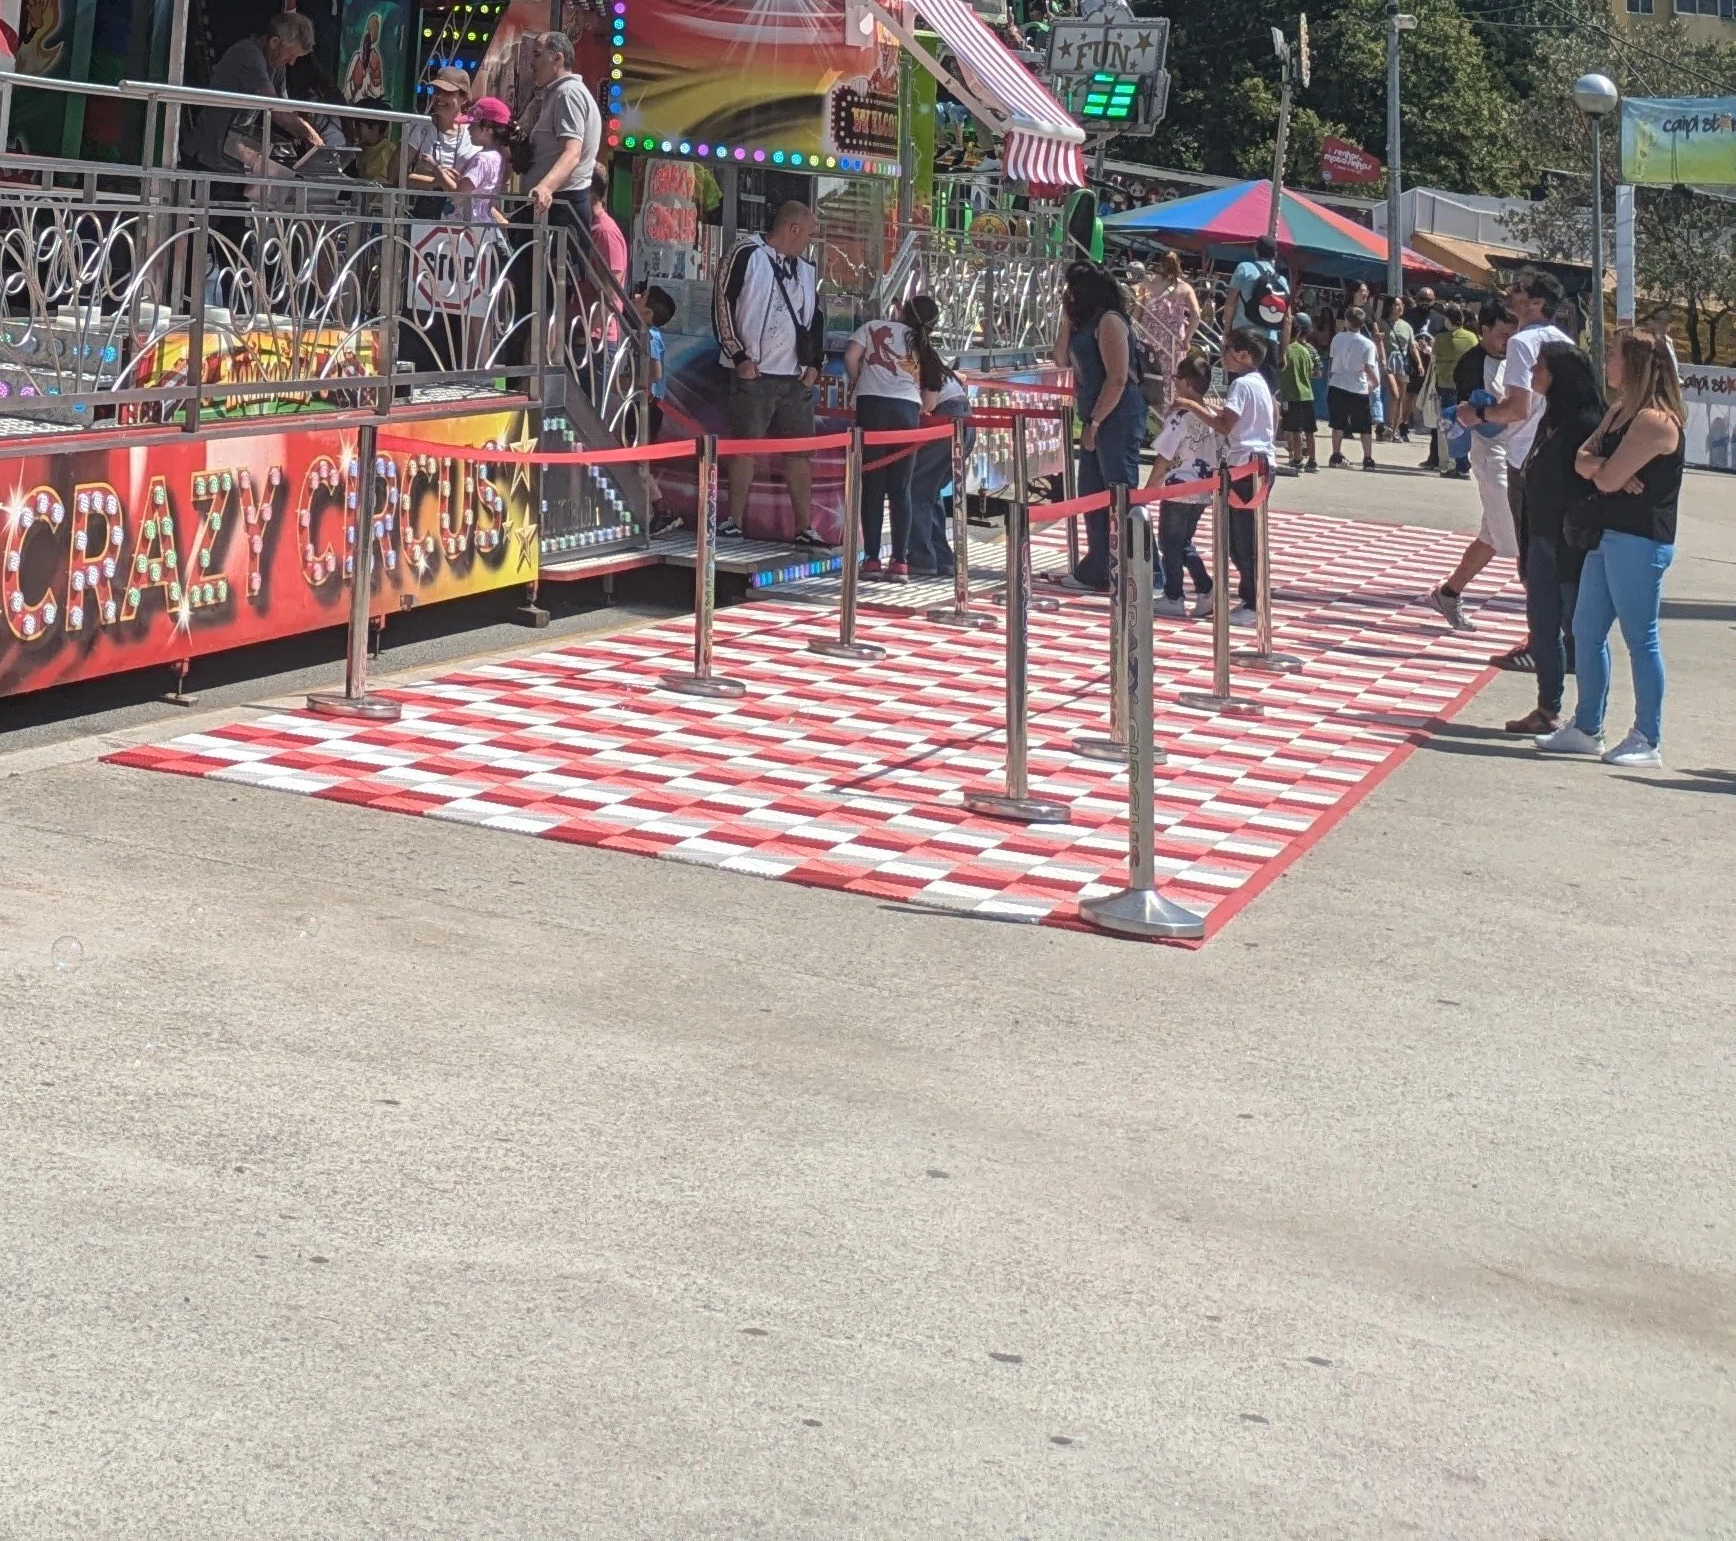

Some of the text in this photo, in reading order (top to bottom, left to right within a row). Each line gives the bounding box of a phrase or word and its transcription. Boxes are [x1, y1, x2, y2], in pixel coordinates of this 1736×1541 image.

[1074, 40, 1131, 71] FUN
[4, 439, 510, 642] CRAZY CIRCUS
